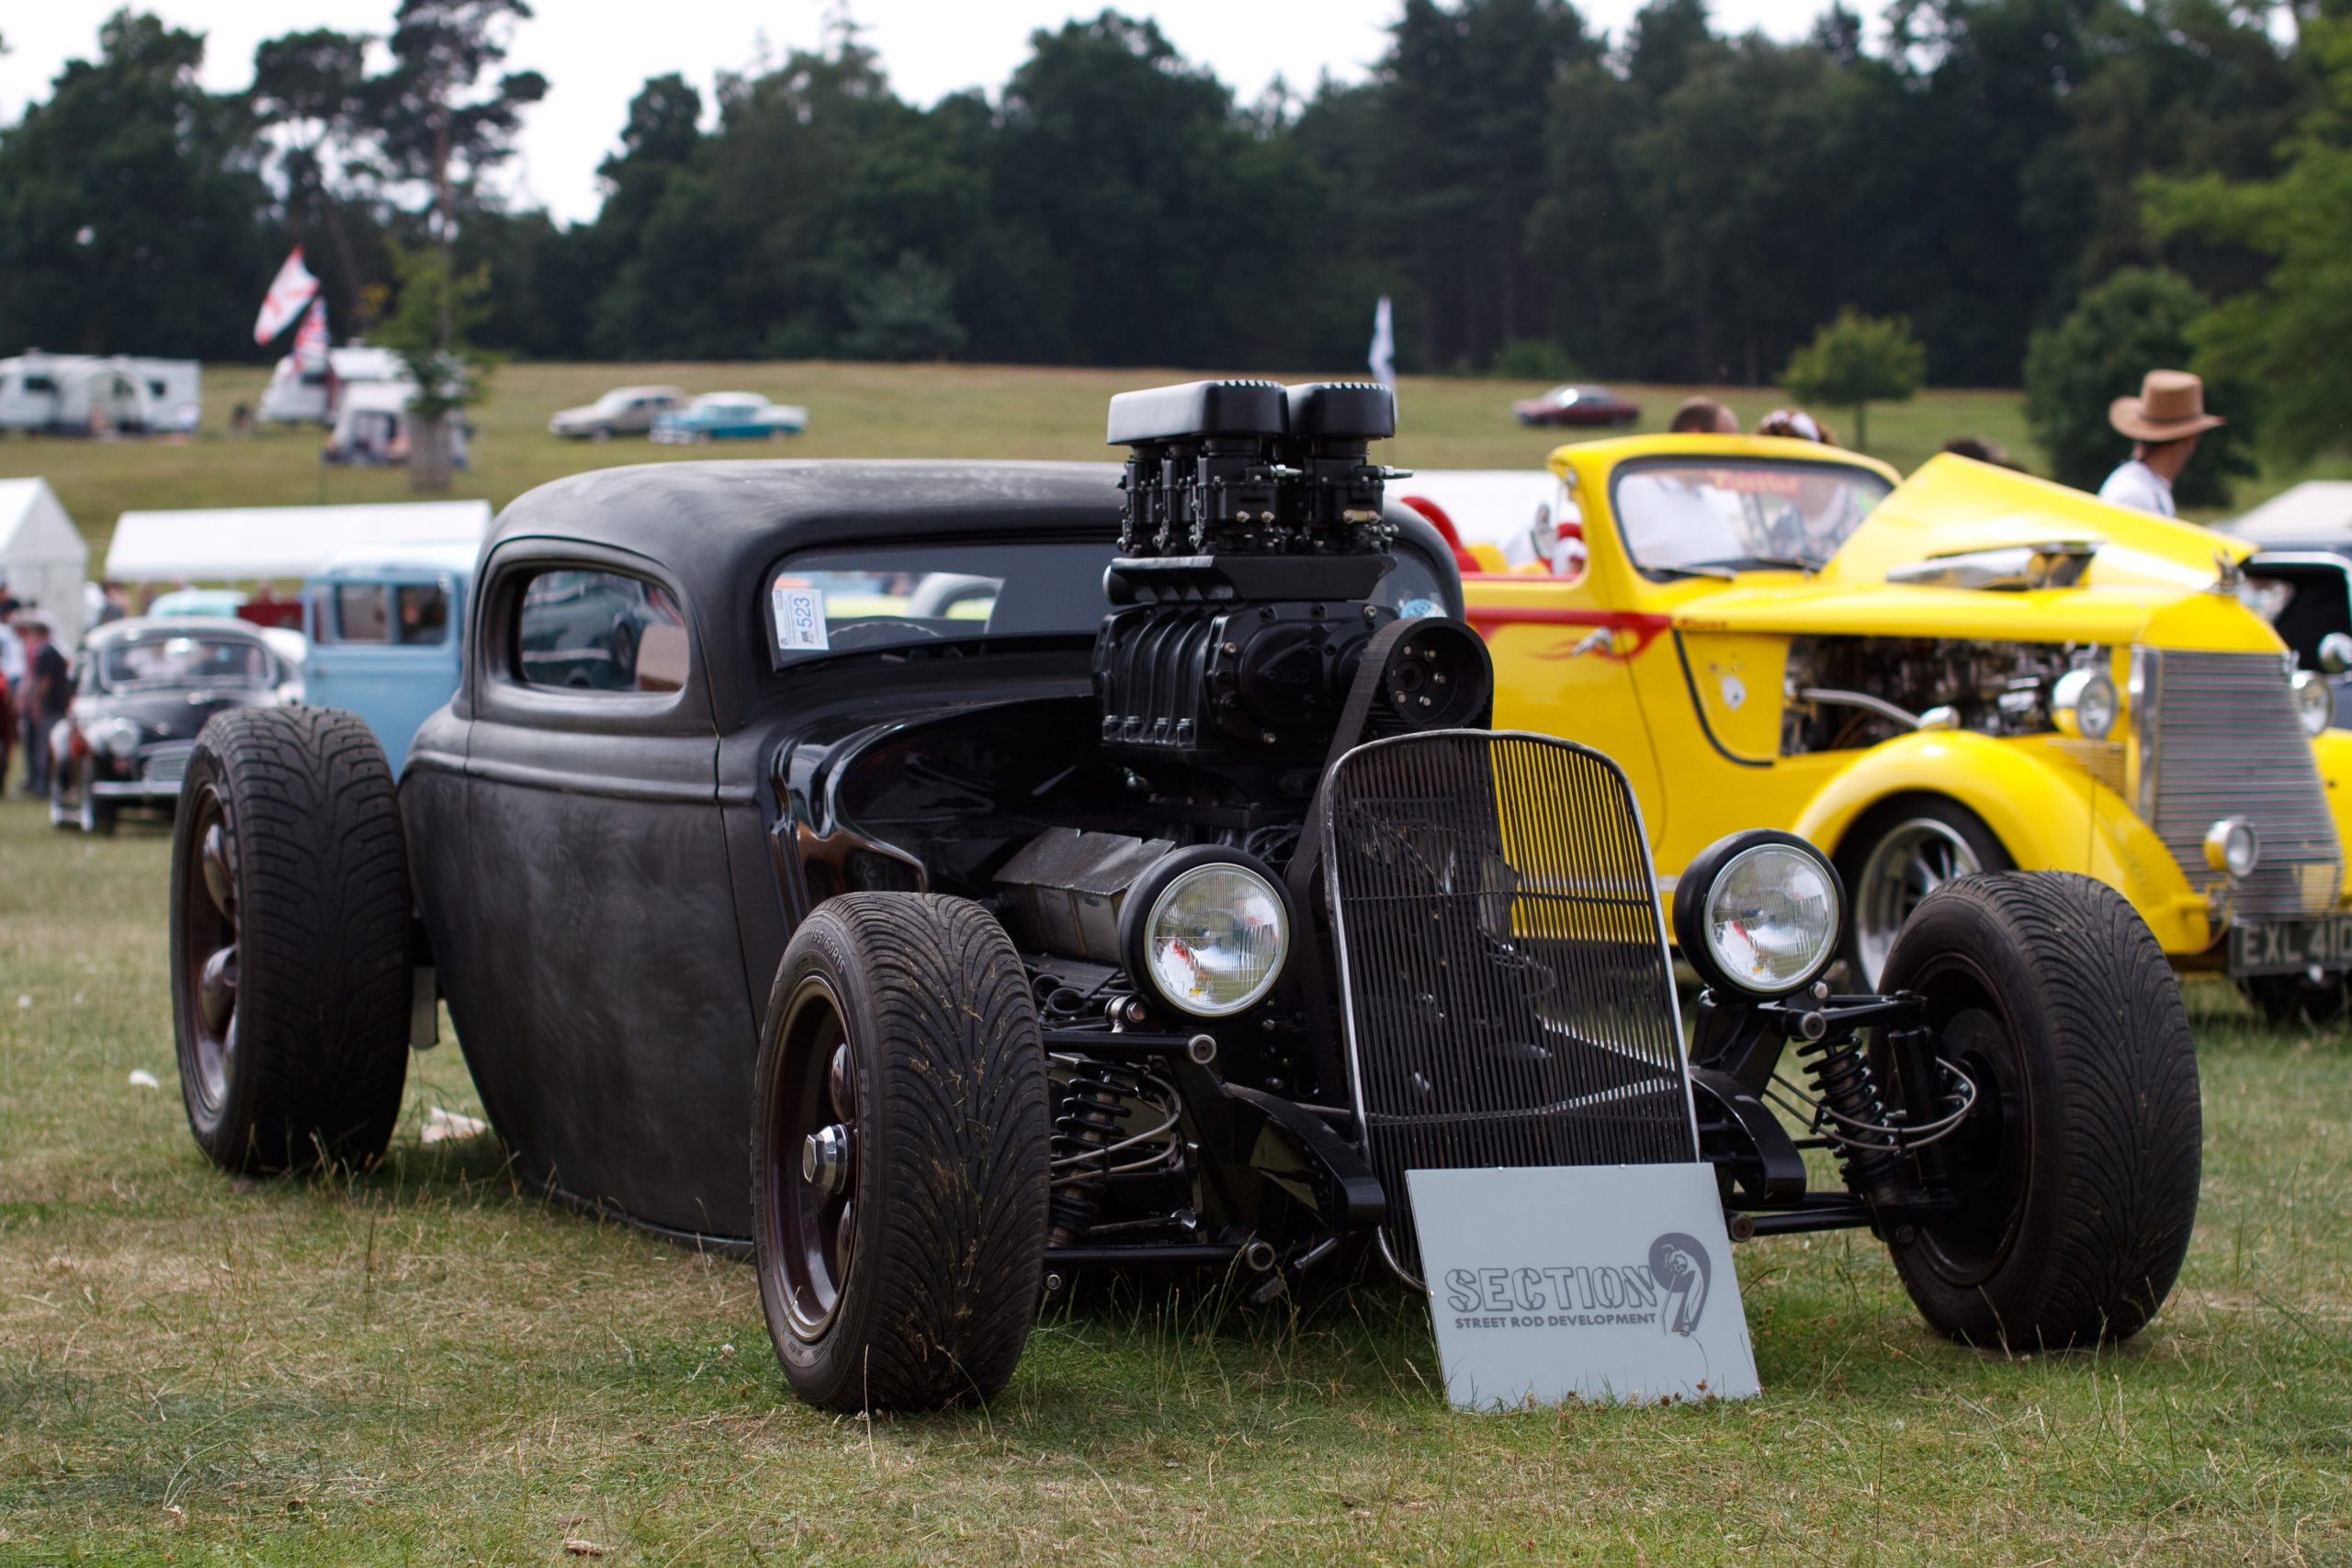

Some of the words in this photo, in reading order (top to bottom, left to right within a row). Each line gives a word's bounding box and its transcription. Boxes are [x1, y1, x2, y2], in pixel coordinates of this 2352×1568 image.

[794, 597, 813, 627] 523
[810, 929, 845, 974] 195/60R15
[2244, 921, 2302, 964] EXL
[1445, 1267, 1657, 1313] SECTION
[1648, 1232, 1712, 1332] 9
[1455, 1316, 1507, 1329] STREET
[1510, 1315, 1544, 1327] ROD
[1547, 1313, 1657, 1326] DEVELOPMENT
